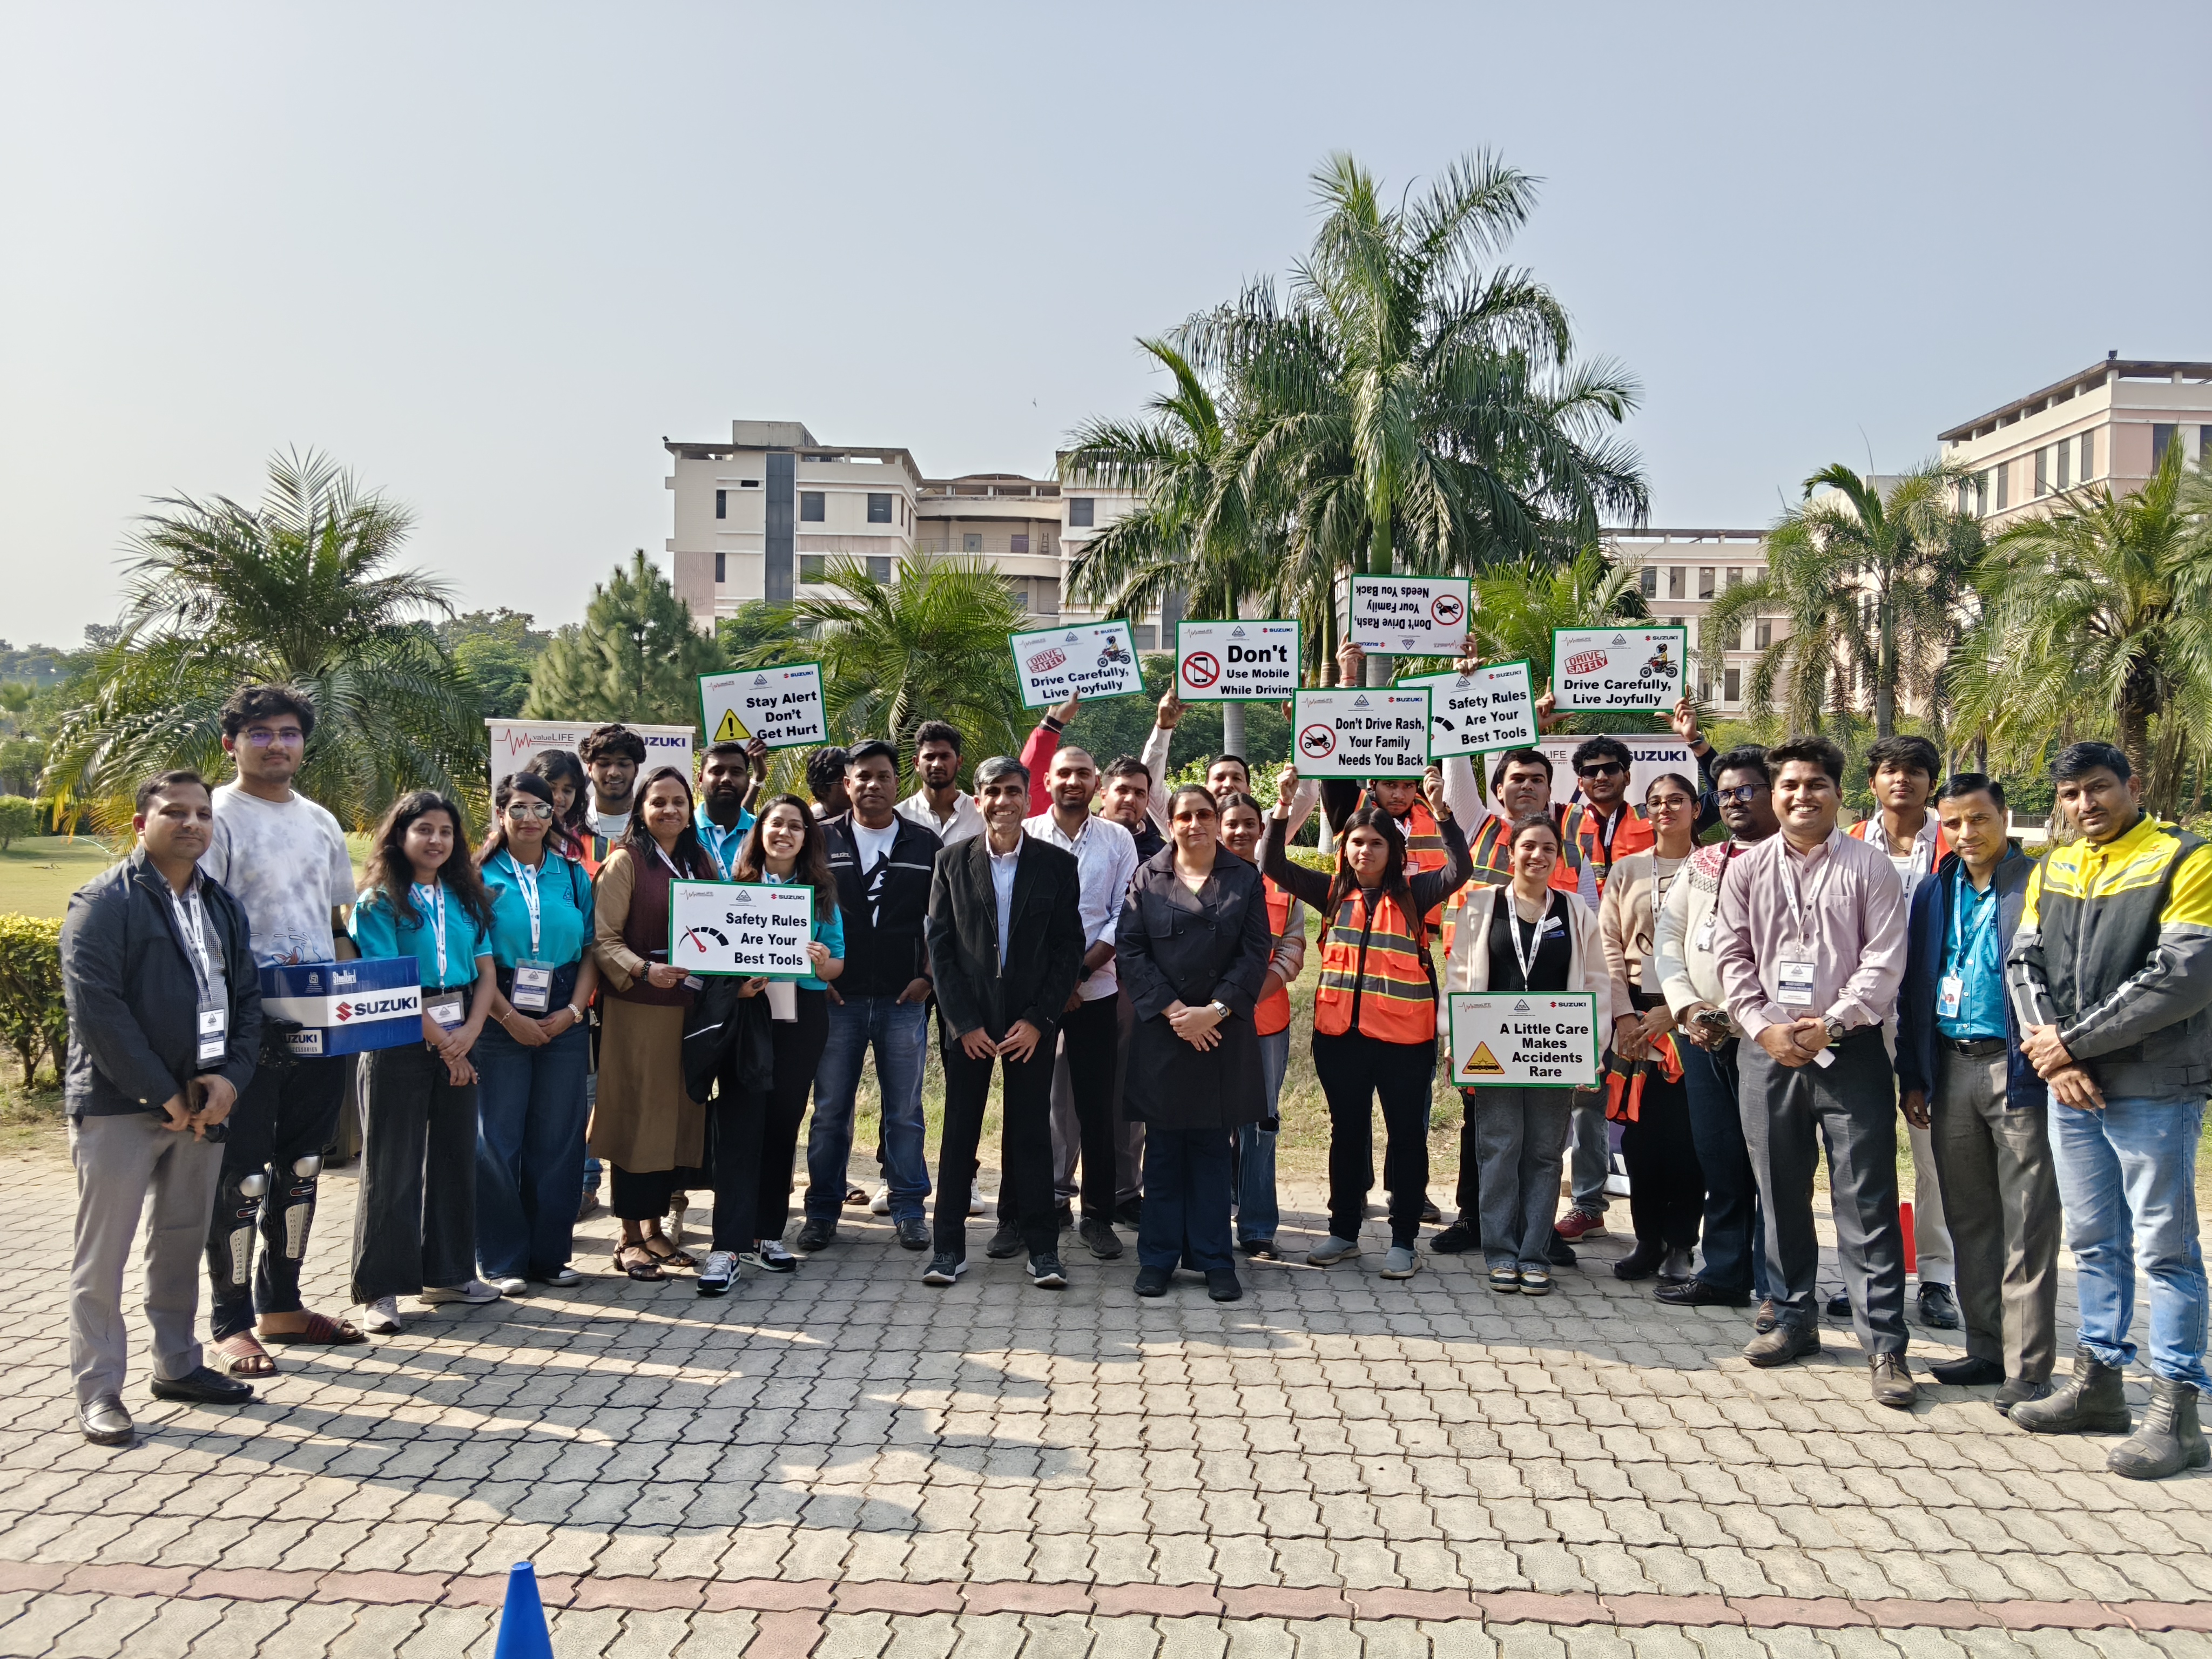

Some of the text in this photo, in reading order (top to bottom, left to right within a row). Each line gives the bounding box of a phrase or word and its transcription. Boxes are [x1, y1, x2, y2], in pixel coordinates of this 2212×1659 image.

[1356, 585, 1429, 598] Needs You Back
[1367, 599, 1419, 613] Your Family
[1354, 615, 1431, 630] Don't Drive Rash,
[1030, 649, 1058, 665] DRIVE
[1228, 645, 1287, 663] Don't
[1569, 651, 1601, 665] DRIVE
[1031, 653, 1066, 673] SAFELY
[1568, 658, 1606, 674] SAFELY
[1031, 667, 1129, 687] Drive Carefully,
[1227, 669, 1290, 678] Use Mobile
[1220, 685, 1252, 694] While
[1564, 679, 1671, 691] Drive Carefully,
[746, 691, 817, 708] Stay Alert
[1043, 689, 1069, 699] Live
[1449, 691, 1527, 710] Safety Rules
[1573, 693, 1661, 706] Live Joyfully
[765, 709, 801, 722] Don't
[1465, 711, 1518, 726] Are Your
[757, 724, 818, 740] Get Hurt
[1336, 718, 1424, 732] Don't Drive Rash,
[1350, 736, 1410, 750] Your Family
[1461, 727, 1527, 745] Best Tools
[1339, 754, 1424, 766] Needs You Back
[1630, 751, 1687, 761] UZUKI
[726, 913, 807, 928] Safety Rules
[741, 933, 797, 946] Are Your
[734, 953, 802, 965] Best Tools
[354, 996, 417, 1016] SUZUKI
[1500, 1023, 1588, 1034] A Little Care
[285, 1034, 317, 1043] UZUKI
[1522, 1037, 1567, 1048] Makes
[1512, 1052, 1582, 1063] Accidents
[1529, 1066, 1561, 1076] Rare
